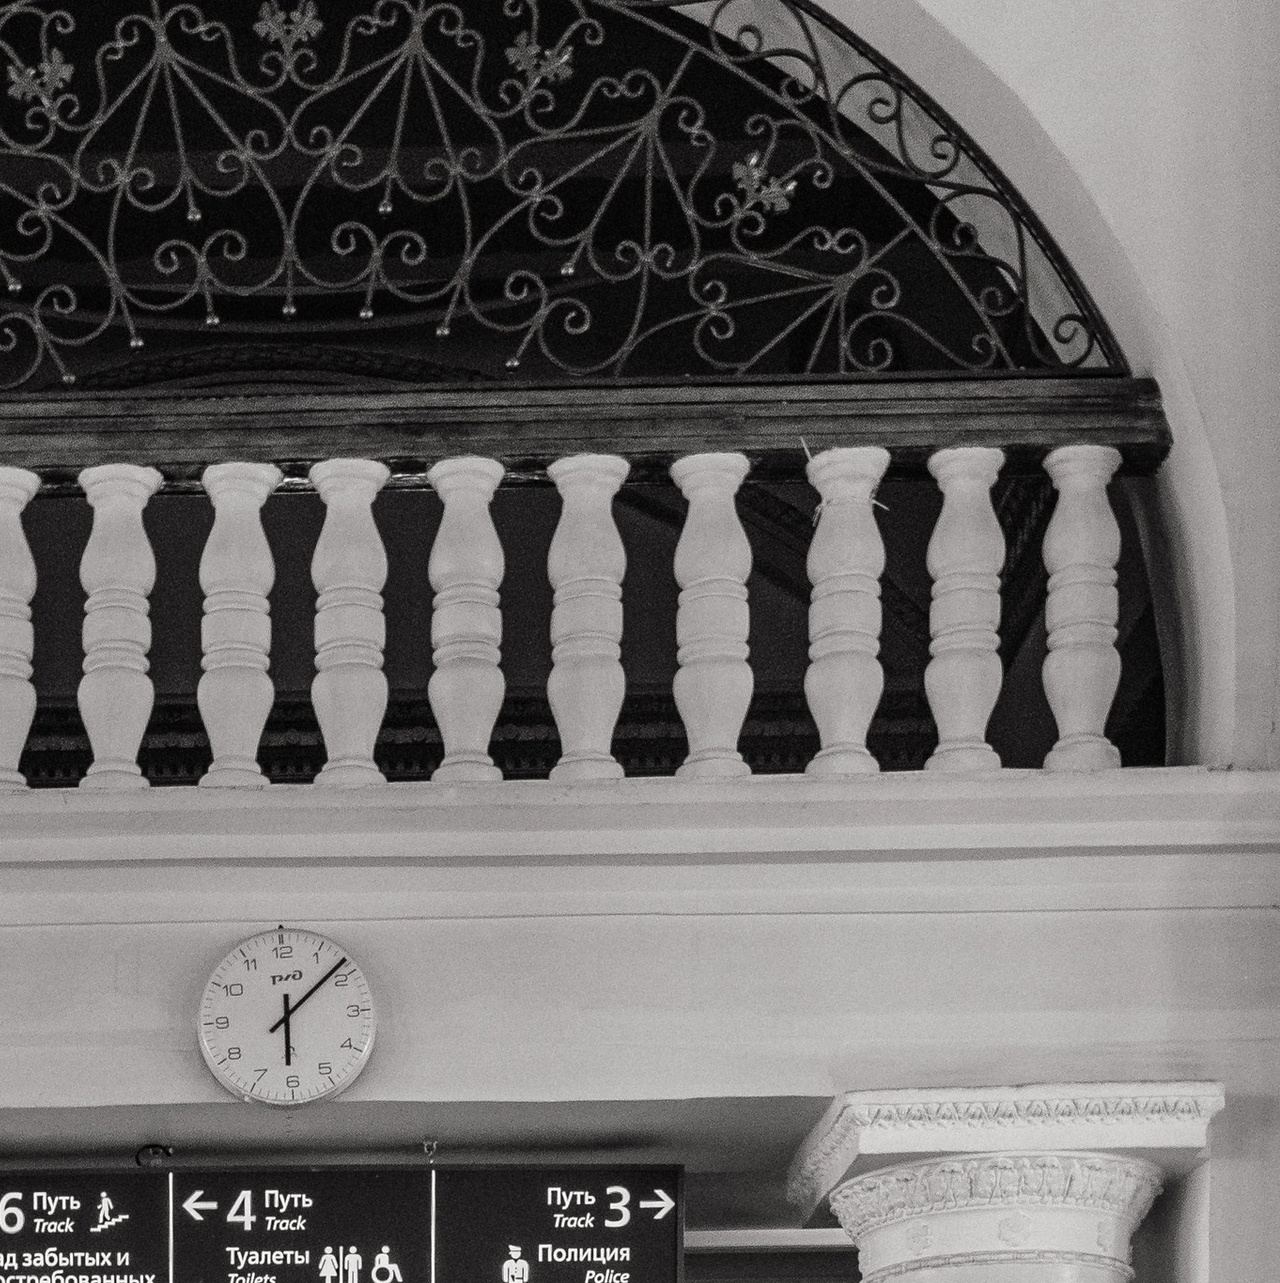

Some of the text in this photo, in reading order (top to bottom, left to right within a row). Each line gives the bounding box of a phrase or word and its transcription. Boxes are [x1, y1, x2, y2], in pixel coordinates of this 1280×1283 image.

[272, 946, 293, 958] 12
[244, 958, 257, 970] 11
[334, 974, 349, 987] 2
[223, 983, 243, 996] 10
[347, 1005, 360, 1017] 3
[216, 1017, 229, 1029] 9
[340, 1038, 352, 1049] 4
[228, 1047, 241, 1060] 8
[254, 1069, 268, 1081] 7
[318, 1062, 332, 1075] 5
[286, 1075, 300, 1088] 6
[33, 1192, 81, 1214] Путь
[547, 1186, 630, 1227] Путь 3
[227, 1190, 313, 1231] 4 Путь
[34, 1217, 74, 1233] Track
[265, 1215, 306, 1230] Track
[554, 1213, 594, 1228] Track
[22, 1247, 112, 1267] забытых
[117, 1252, 129, 1266] и
[226, 1247, 309, 1270] Туалеты
[538, 1244, 630, 1264] Полиция
[585, 1269, 630, 1283] Police
